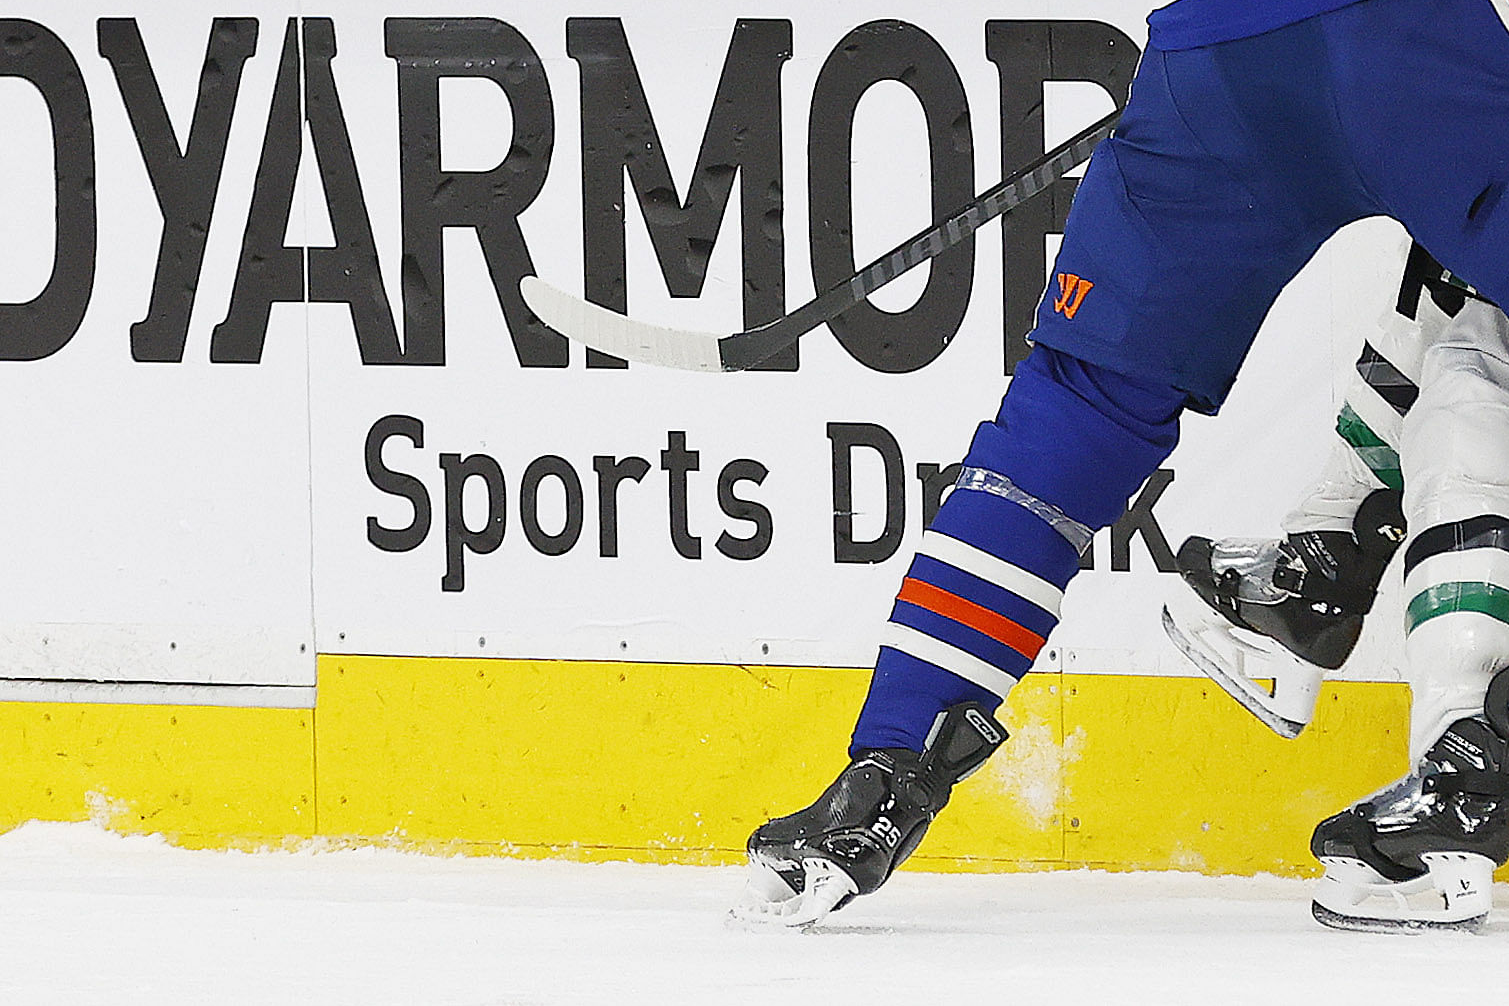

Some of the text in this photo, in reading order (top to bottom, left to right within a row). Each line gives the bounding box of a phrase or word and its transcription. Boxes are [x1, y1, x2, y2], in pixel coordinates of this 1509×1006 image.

[363, 415, 1182, 592] Sports Drk
[970, 713, 998, 742] CCM
[871, 815, 901, 849] 25
